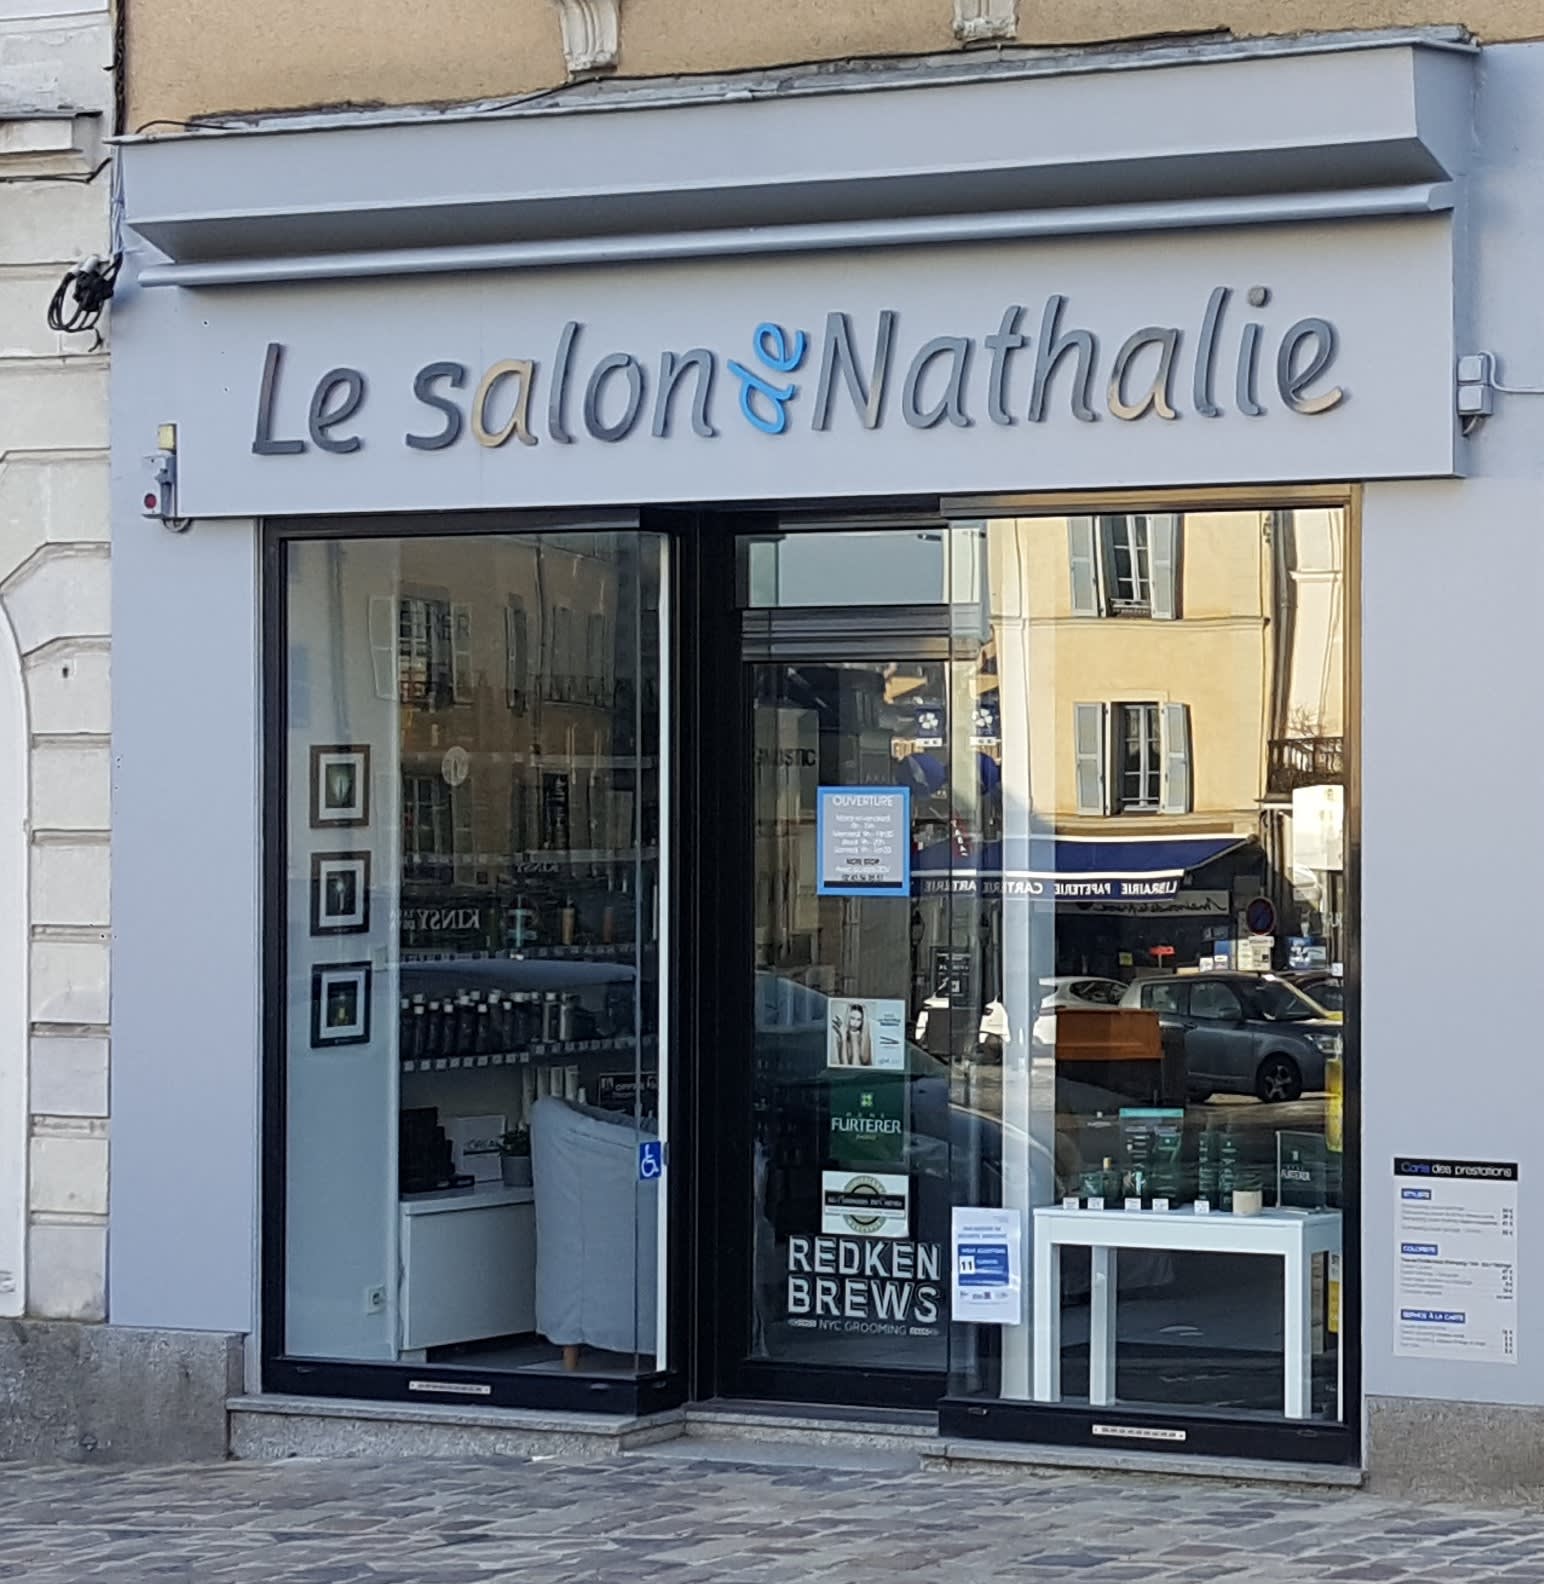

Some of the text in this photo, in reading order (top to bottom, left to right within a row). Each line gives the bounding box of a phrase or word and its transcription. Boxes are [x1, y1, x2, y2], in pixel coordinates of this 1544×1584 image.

[251, 284, 1347, 456] Le salon de Nathalie
[832, 795, 895, 807] OUVERTURE
[831, 1117, 902, 1134] FURTERER
[788, 1234, 942, 1281] REDKEN
[961, 1260, 973, 1271] 11
[788, 1274, 940, 1323] BREWS
[819, 1319, 843, 1331] NYC
[844, 1321, 907, 1335] GROOMING
